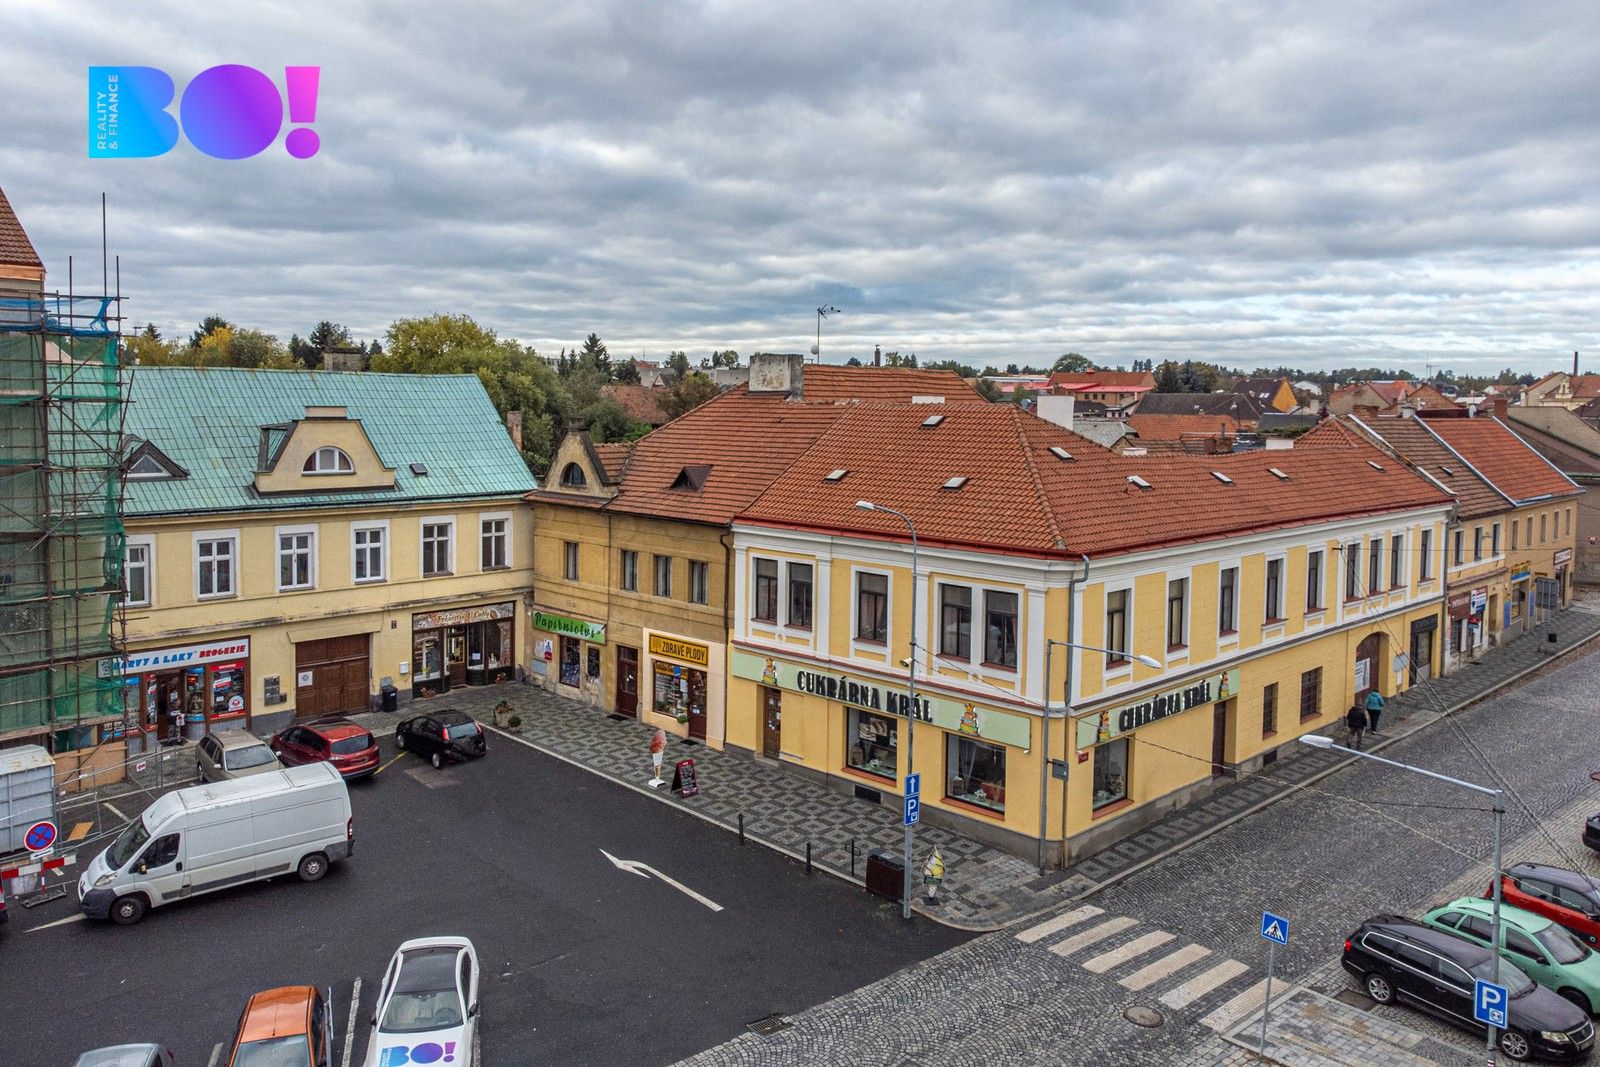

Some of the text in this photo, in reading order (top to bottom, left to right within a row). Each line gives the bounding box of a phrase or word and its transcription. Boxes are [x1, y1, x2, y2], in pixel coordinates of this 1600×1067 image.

[163, 651, 194, 664] LAKY
[199, 644, 246, 659] DROGERIE
[685, 646, 706, 662] PLODY
[797, 670, 933, 723] CUKRÁRNA KRÁL
[907, 799, 917, 816] P
[1481, 985, 1501, 1010] P
